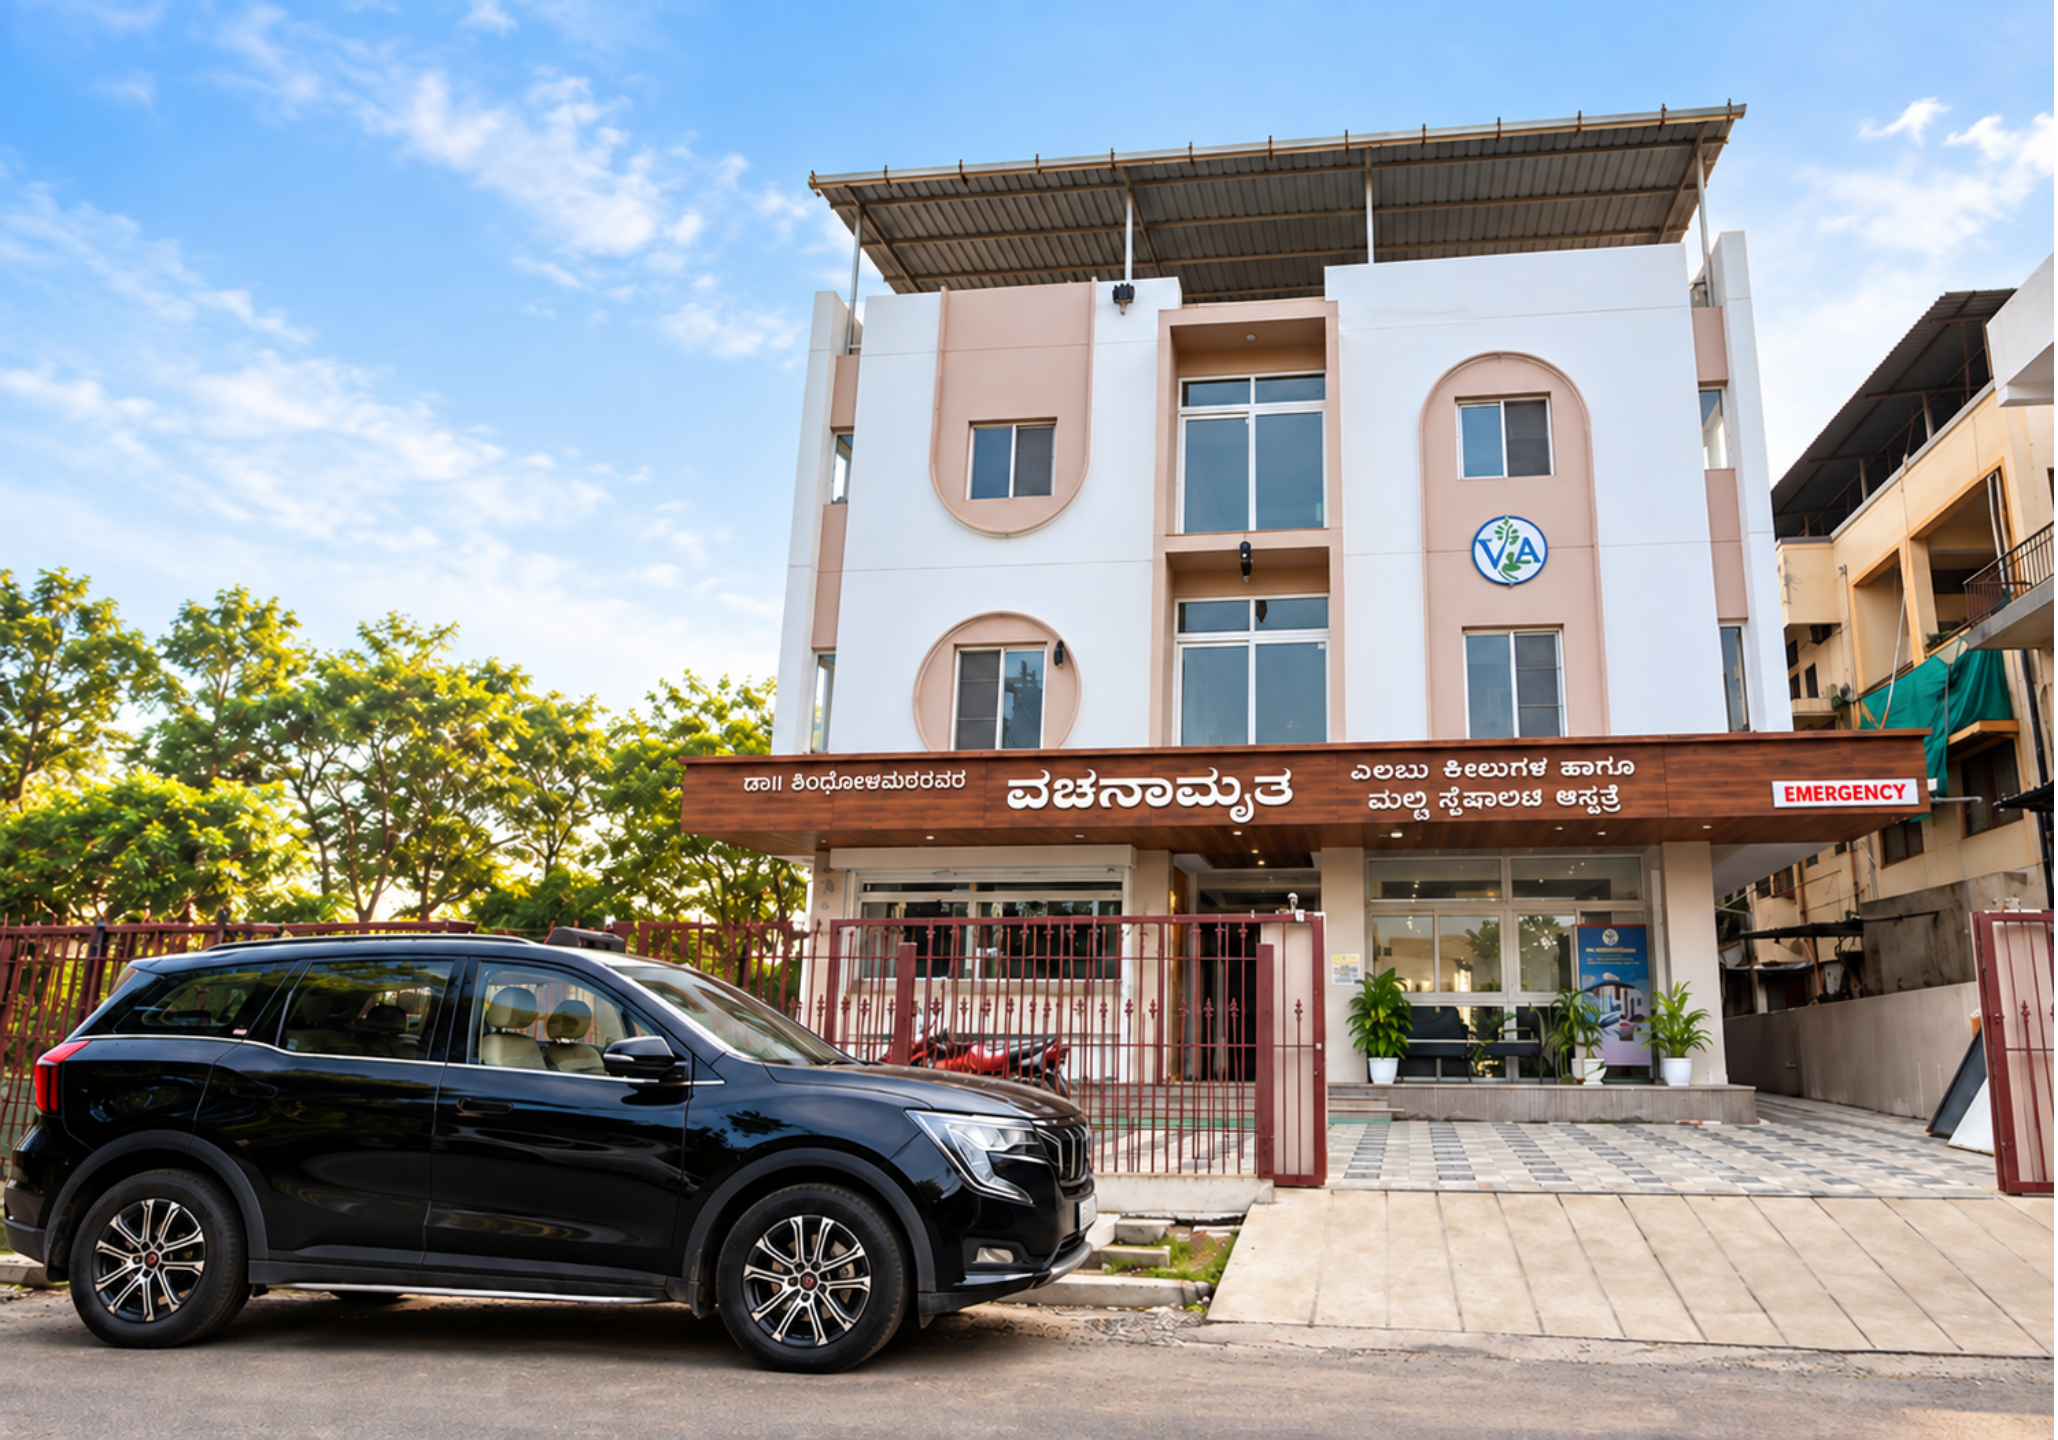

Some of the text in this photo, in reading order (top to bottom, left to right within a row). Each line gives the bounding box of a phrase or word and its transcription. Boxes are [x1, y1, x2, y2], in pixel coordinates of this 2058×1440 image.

[1350, 755, 1635, 780] ಎಲಬು ಕೀಲುಗಳ ಹಾಗೂ
[1007, 767, 1294, 823] ವಚನಾಮೃತ
[1368, 789, 1431, 821] ಮಲ್ಟಿ
[1555, 784, 1622, 815] ಆಸ್ಪತ್ರೆ
[1784, 783, 1906, 803] EMERGENCY
